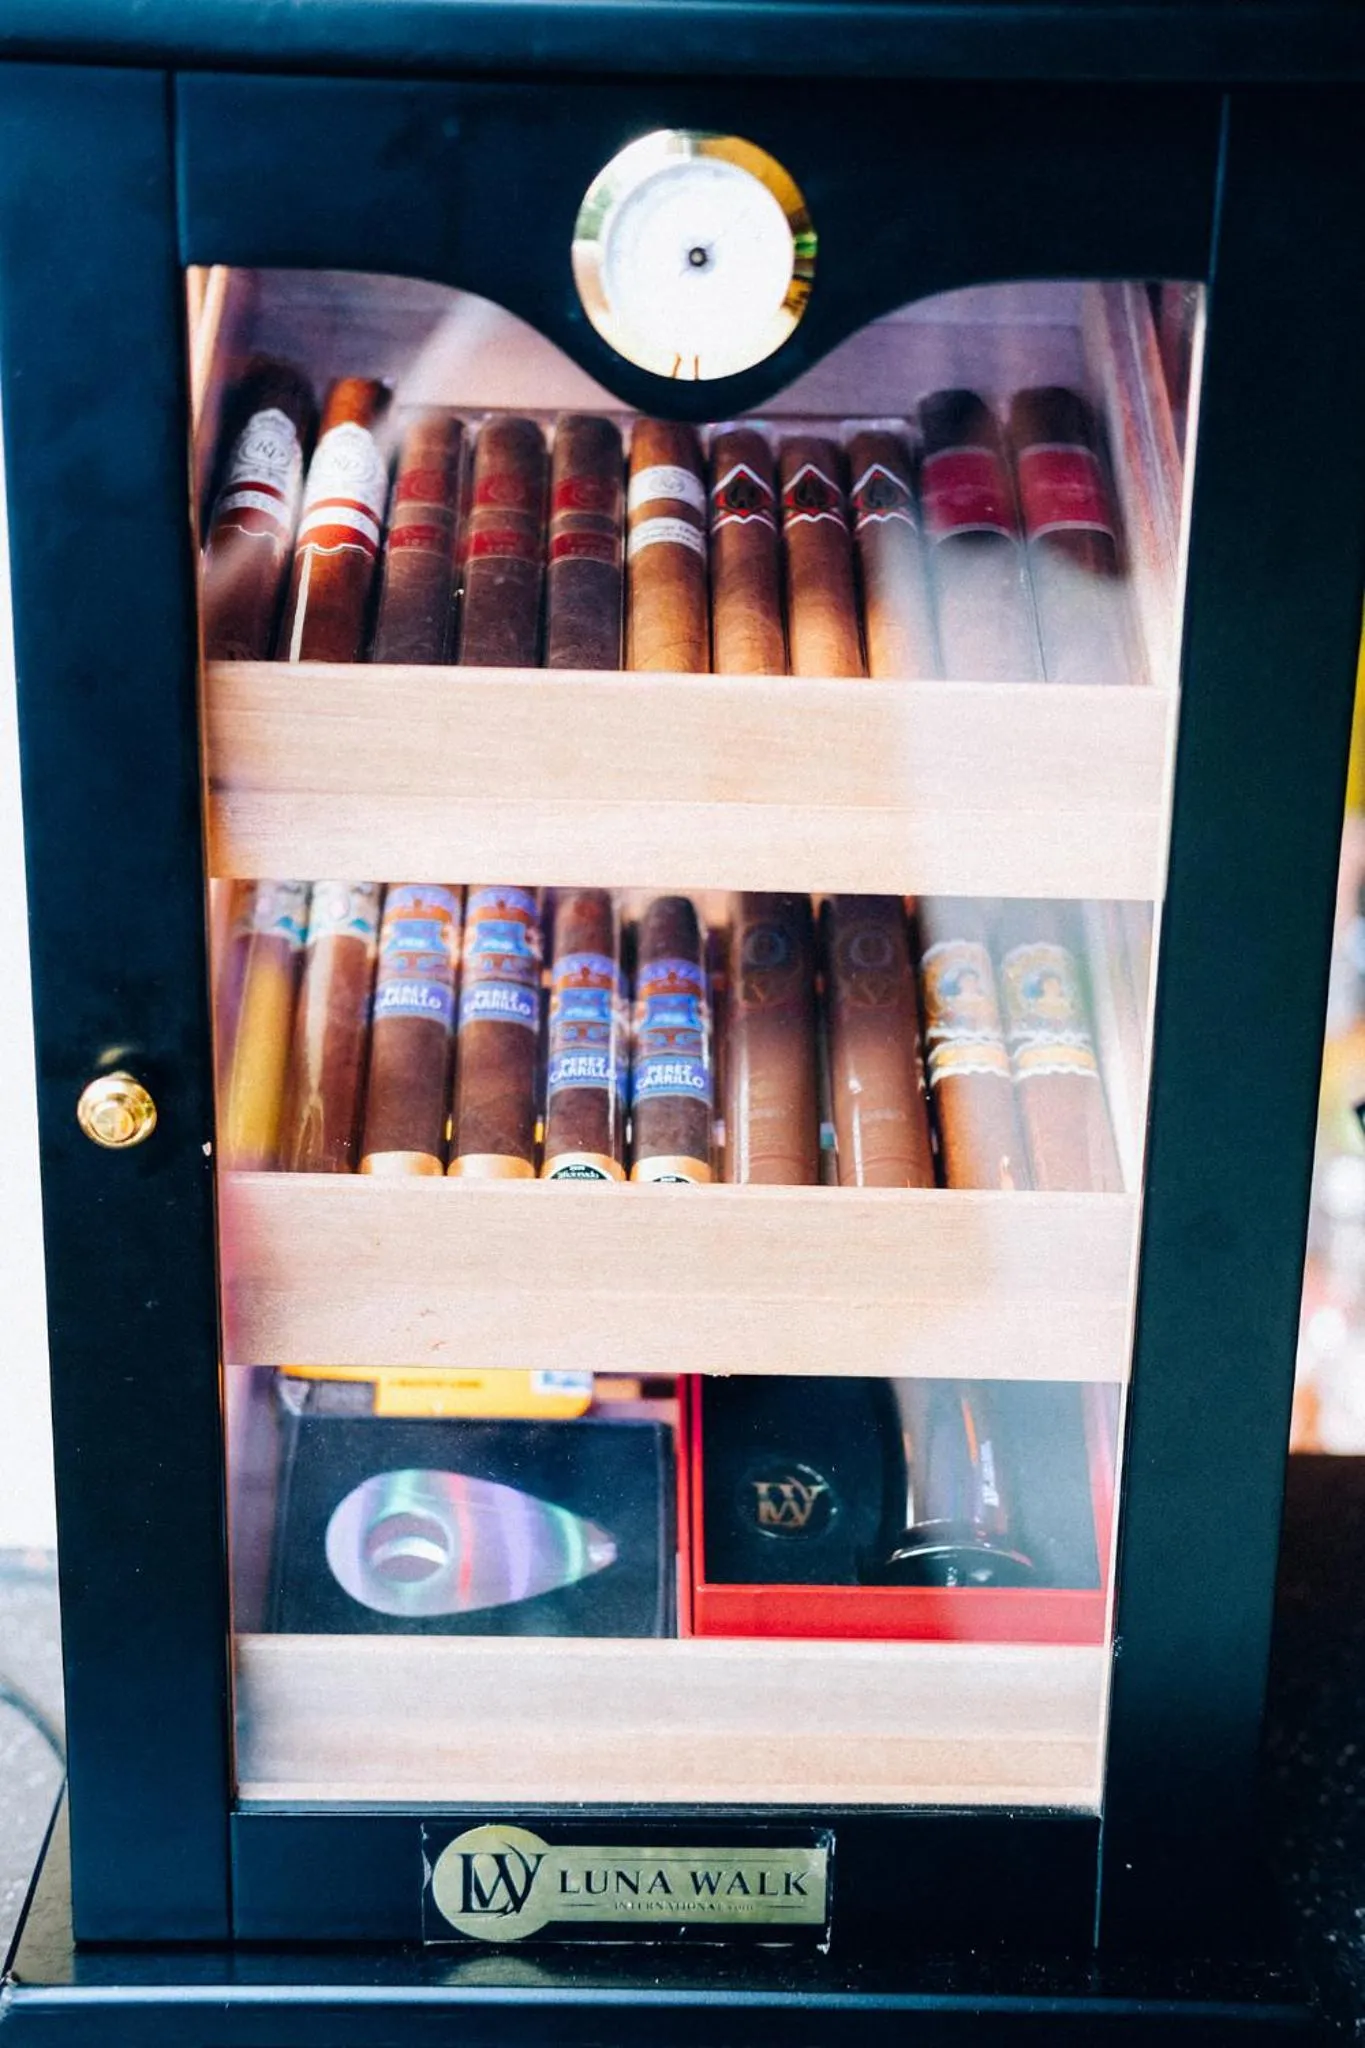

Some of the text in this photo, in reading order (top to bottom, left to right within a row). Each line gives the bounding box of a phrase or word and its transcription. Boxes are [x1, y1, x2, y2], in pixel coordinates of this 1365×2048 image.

[559, 1056, 607, 1070] PEREZ
[646, 1064, 693, 1077] PEREZ
[549, 1066, 618, 1084] CARRILLO
[635, 1073, 705, 1090] CARRILLO
[559, 1868, 809, 1897] LUNA WALK
